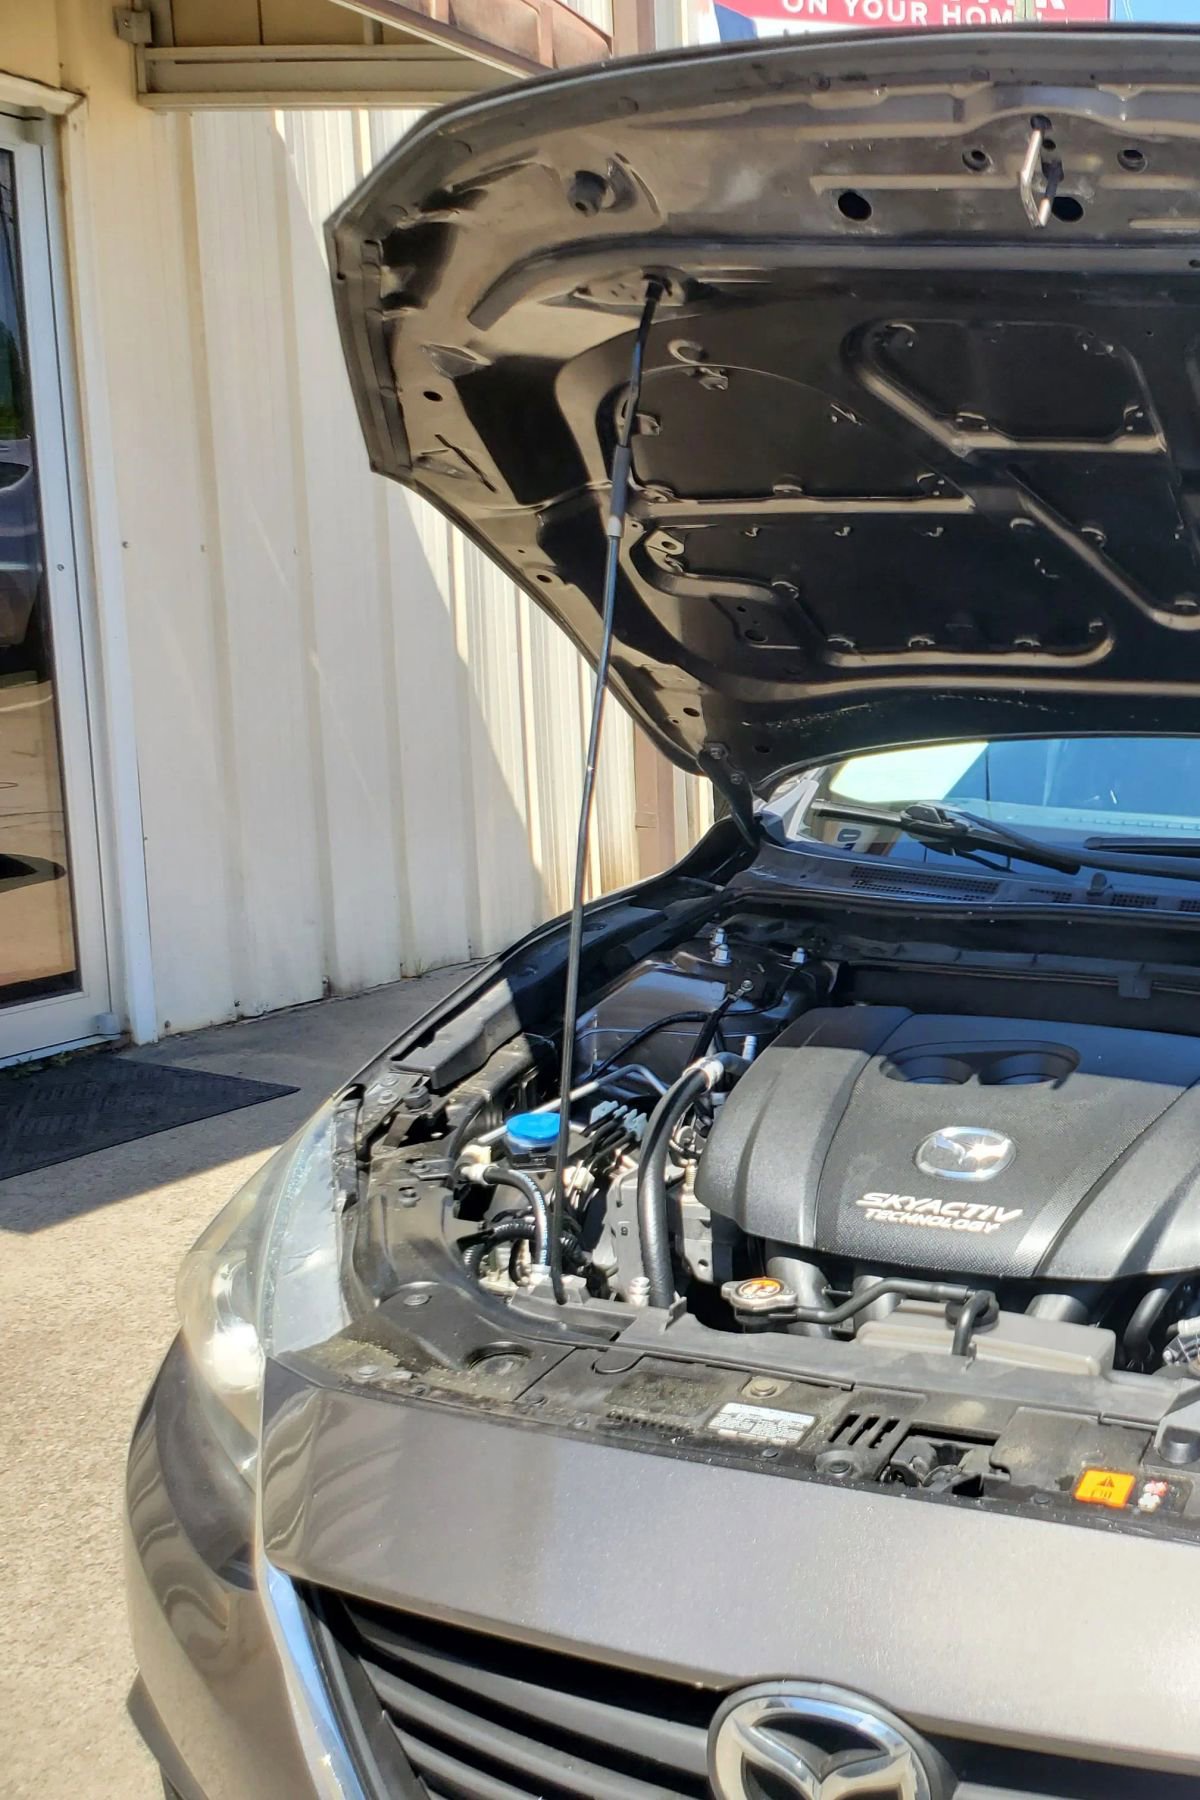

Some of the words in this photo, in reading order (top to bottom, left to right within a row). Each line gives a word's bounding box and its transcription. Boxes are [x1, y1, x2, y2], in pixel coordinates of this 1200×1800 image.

[782, 0, 828, 15] ON
[844, 0, 928, 26] YOUR
[942, 3, 1042, 25] HOM
[855, 1192, 1024, 1222] SKYACTIV
[865, 1208, 1001, 1234] TECHNOLOGY
